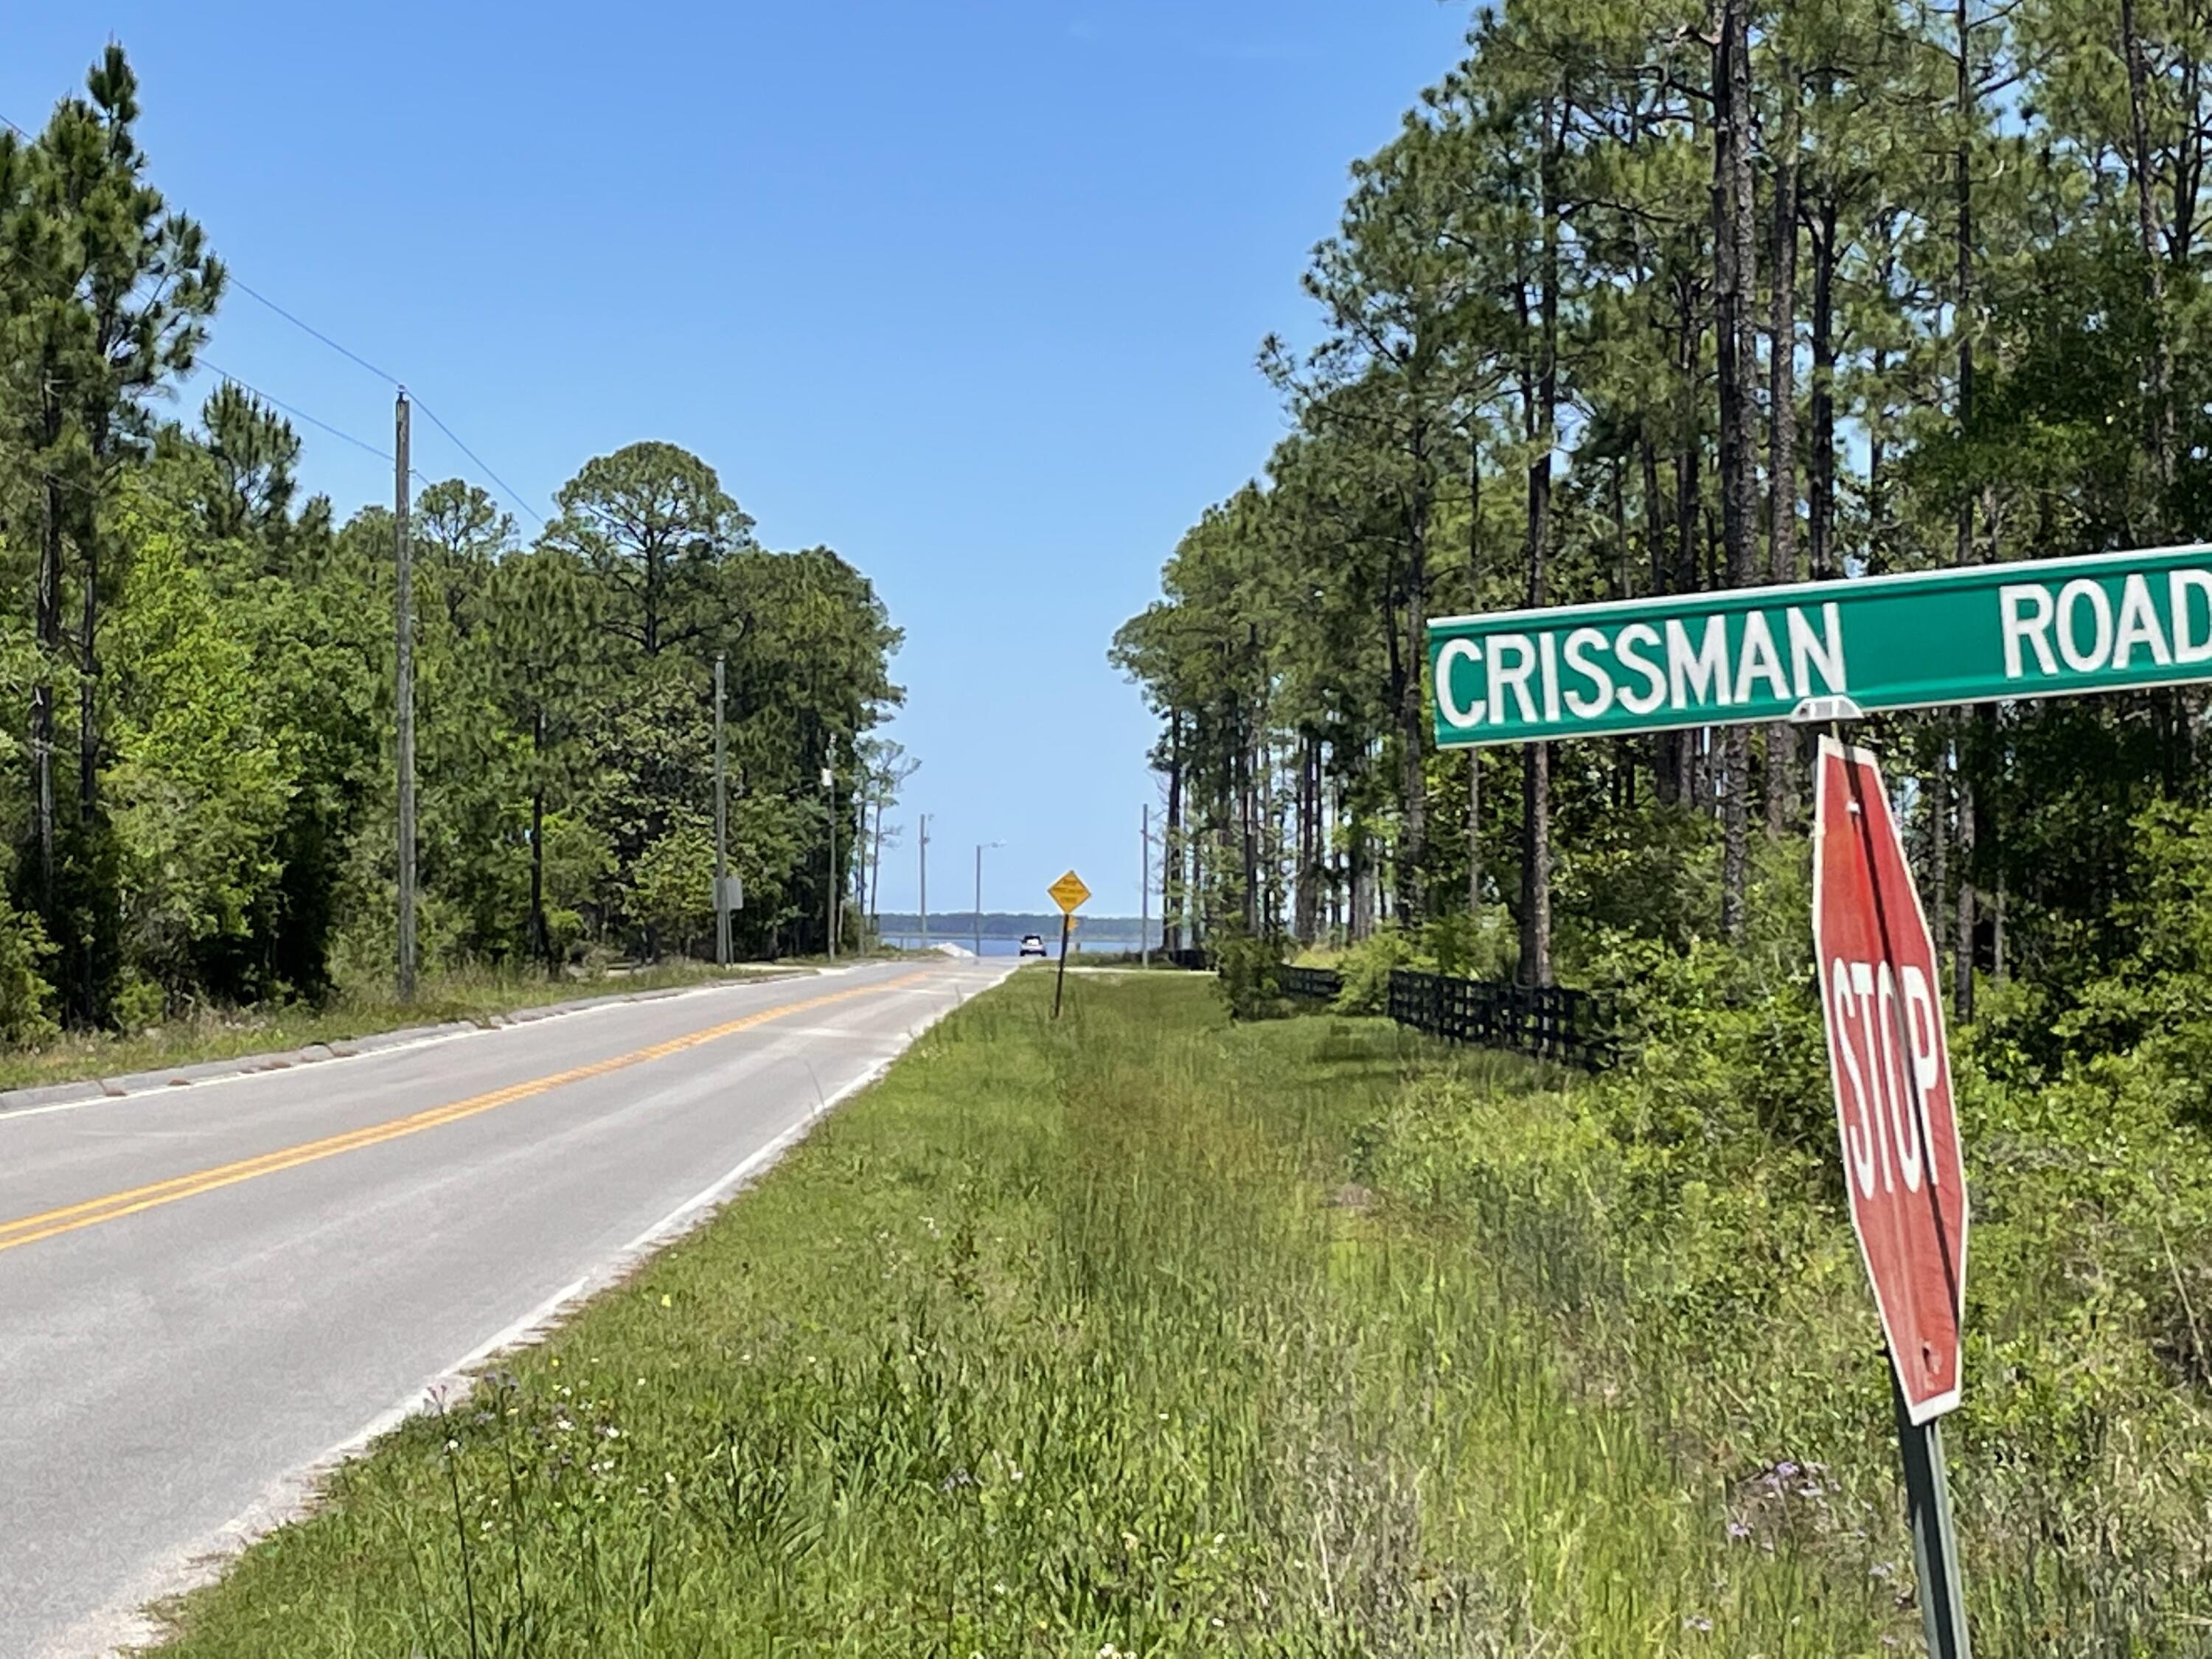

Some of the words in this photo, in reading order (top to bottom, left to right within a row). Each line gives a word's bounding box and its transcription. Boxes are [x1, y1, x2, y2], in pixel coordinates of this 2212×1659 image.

[1435, 602, 1847, 728] CRISSMAN
[1999, 569, 2212, 679] ROAD
[1833, 957, 1938, 1200] STOP
